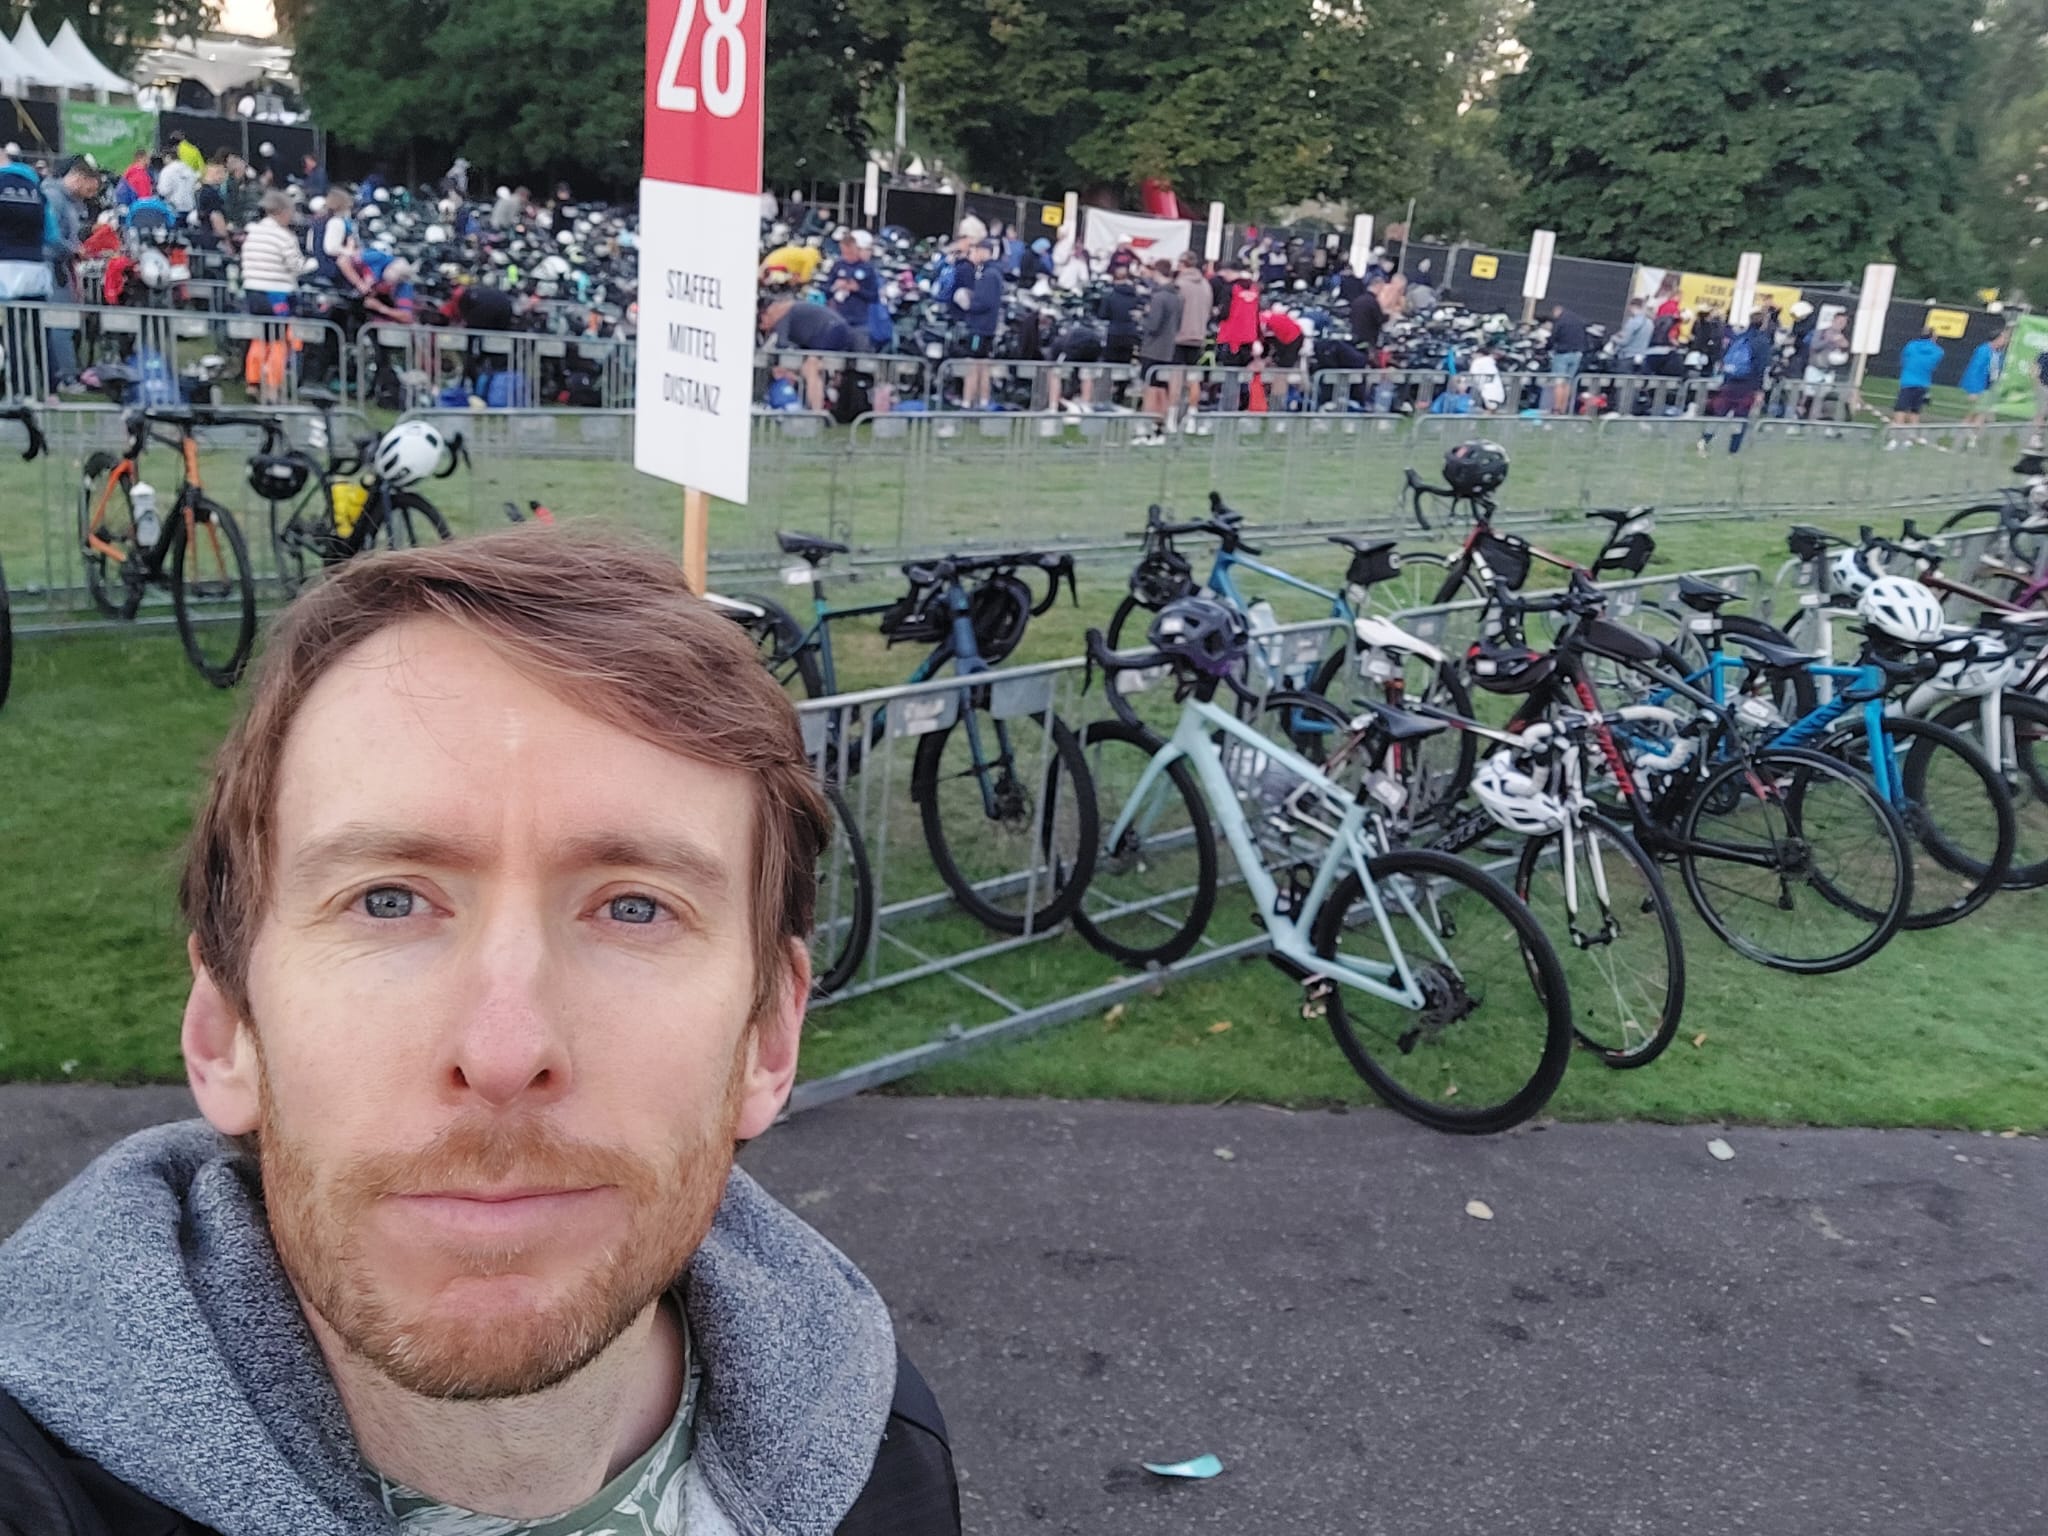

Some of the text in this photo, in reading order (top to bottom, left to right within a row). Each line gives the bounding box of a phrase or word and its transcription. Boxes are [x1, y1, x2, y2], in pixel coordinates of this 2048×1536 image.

[656, 0, 748, 118] 28
[666, 268, 723, 310] STAFFEL
[666, 321, 718, 363] MITTEL
[663, 372, 721, 416] DISTANZ
